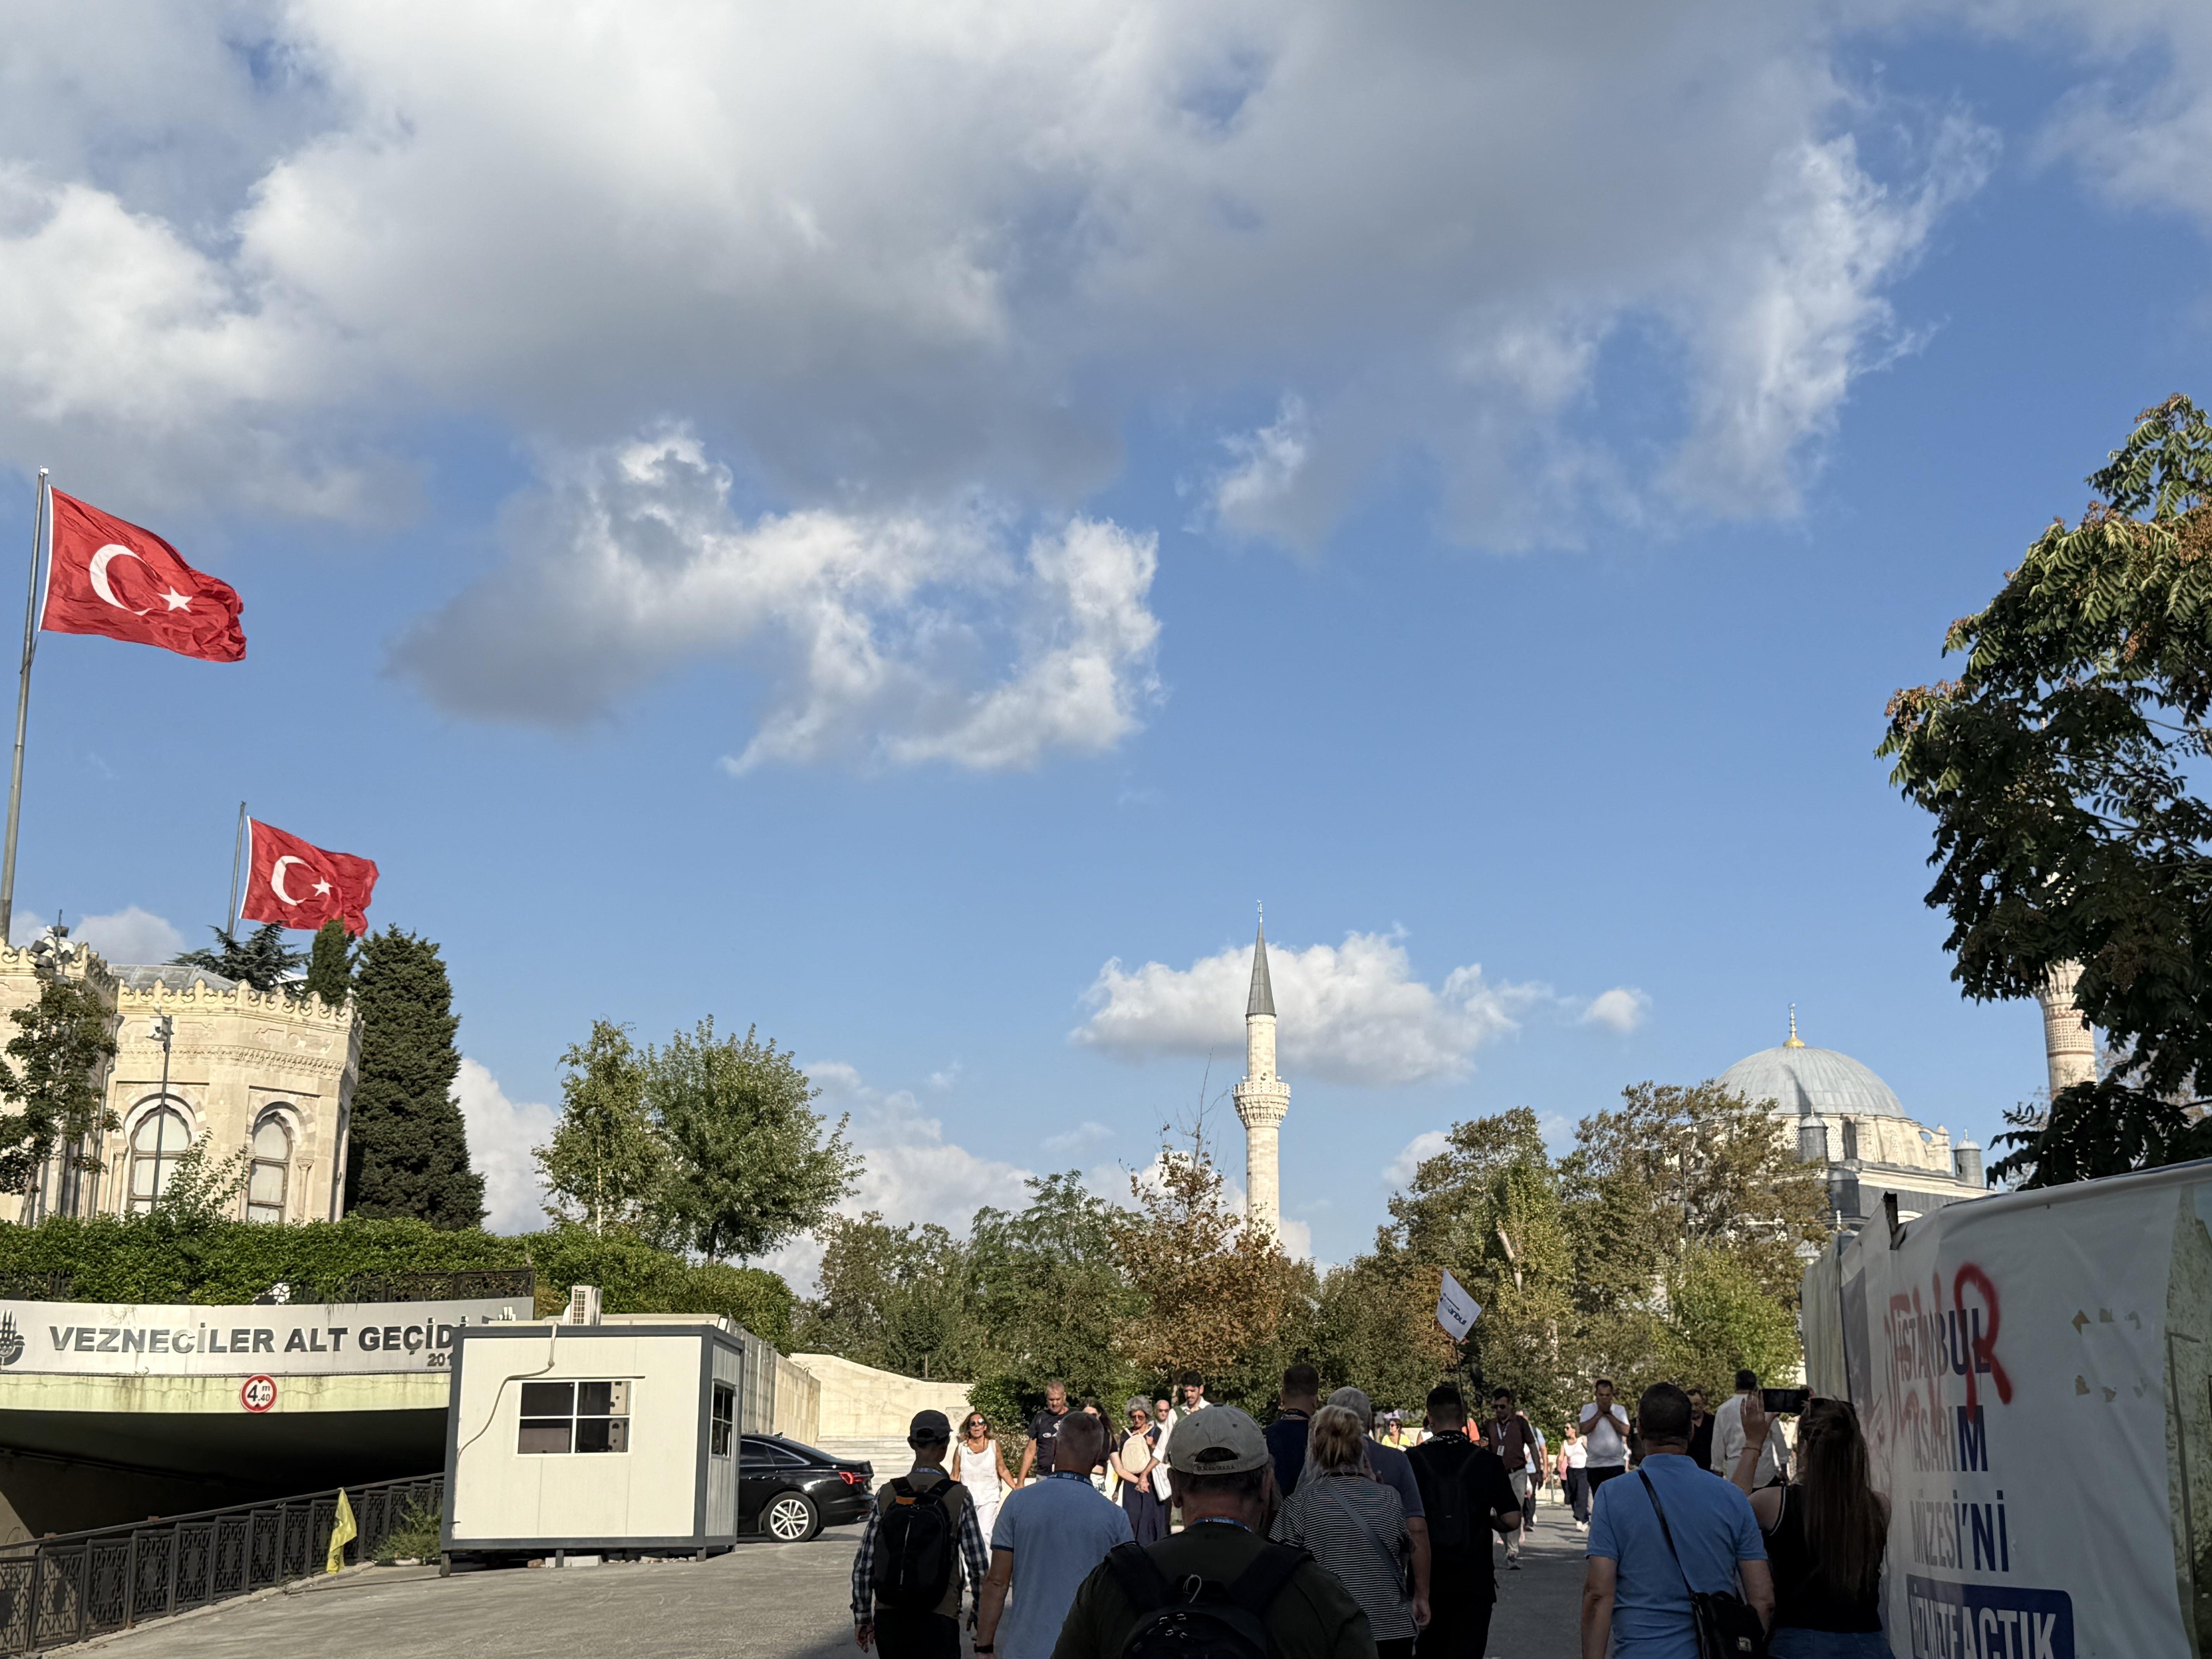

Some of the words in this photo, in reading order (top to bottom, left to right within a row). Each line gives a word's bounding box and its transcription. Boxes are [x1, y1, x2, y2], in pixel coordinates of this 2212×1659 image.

[49, 1322, 275, 1353] VEZNECİLER
[284, 1327, 349, 1353] ALT
[359, 1316, 467, 1355] GEÇİD
